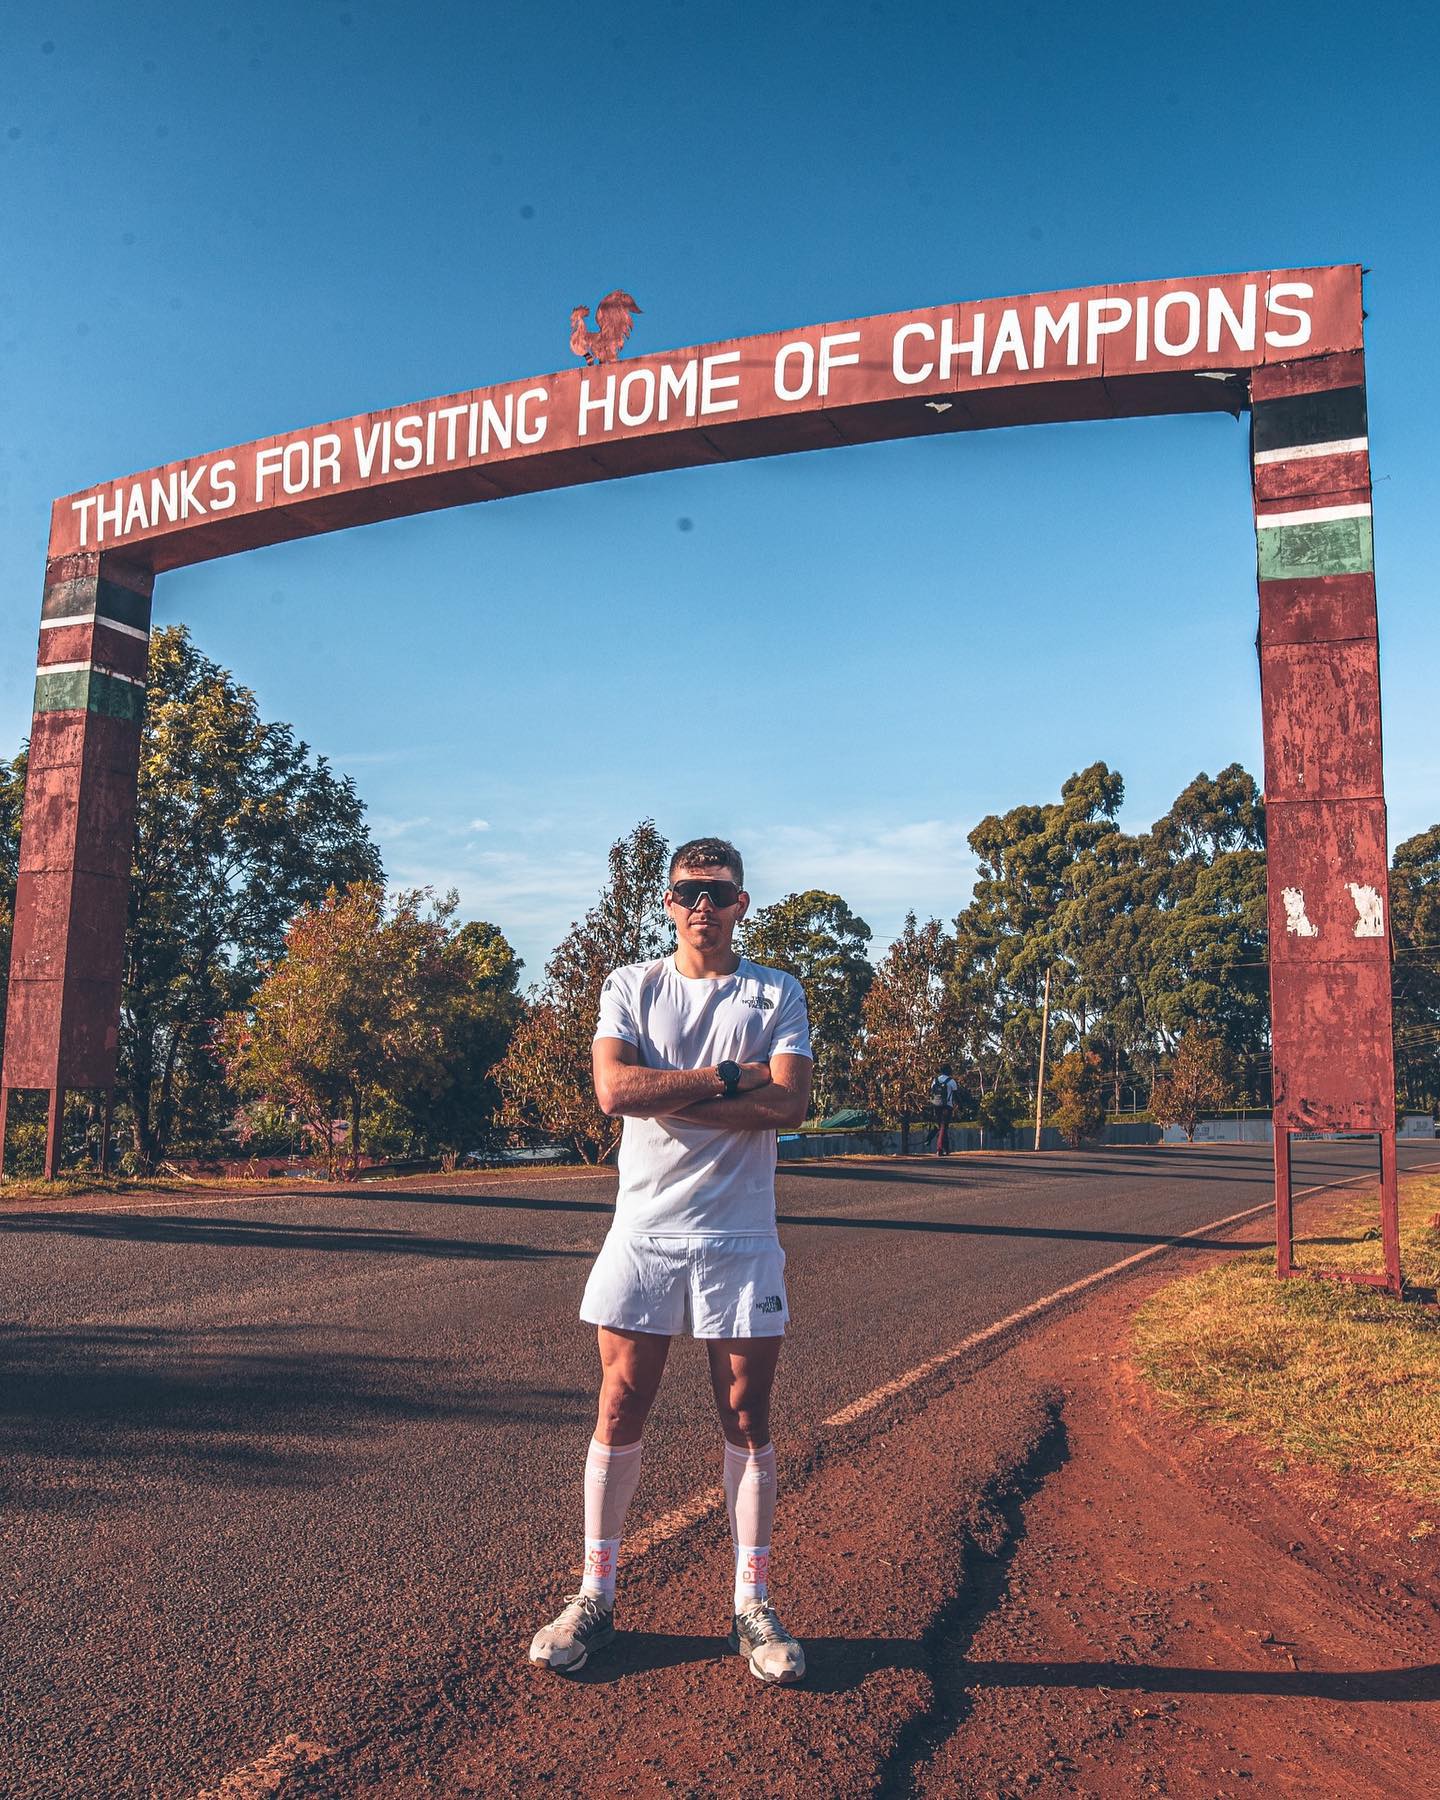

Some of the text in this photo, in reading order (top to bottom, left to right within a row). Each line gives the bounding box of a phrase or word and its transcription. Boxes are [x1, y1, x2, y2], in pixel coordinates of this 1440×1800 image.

[71, 281, 1315, 547] THANKS FOR VISITING HOME OF CHAMPIONS
